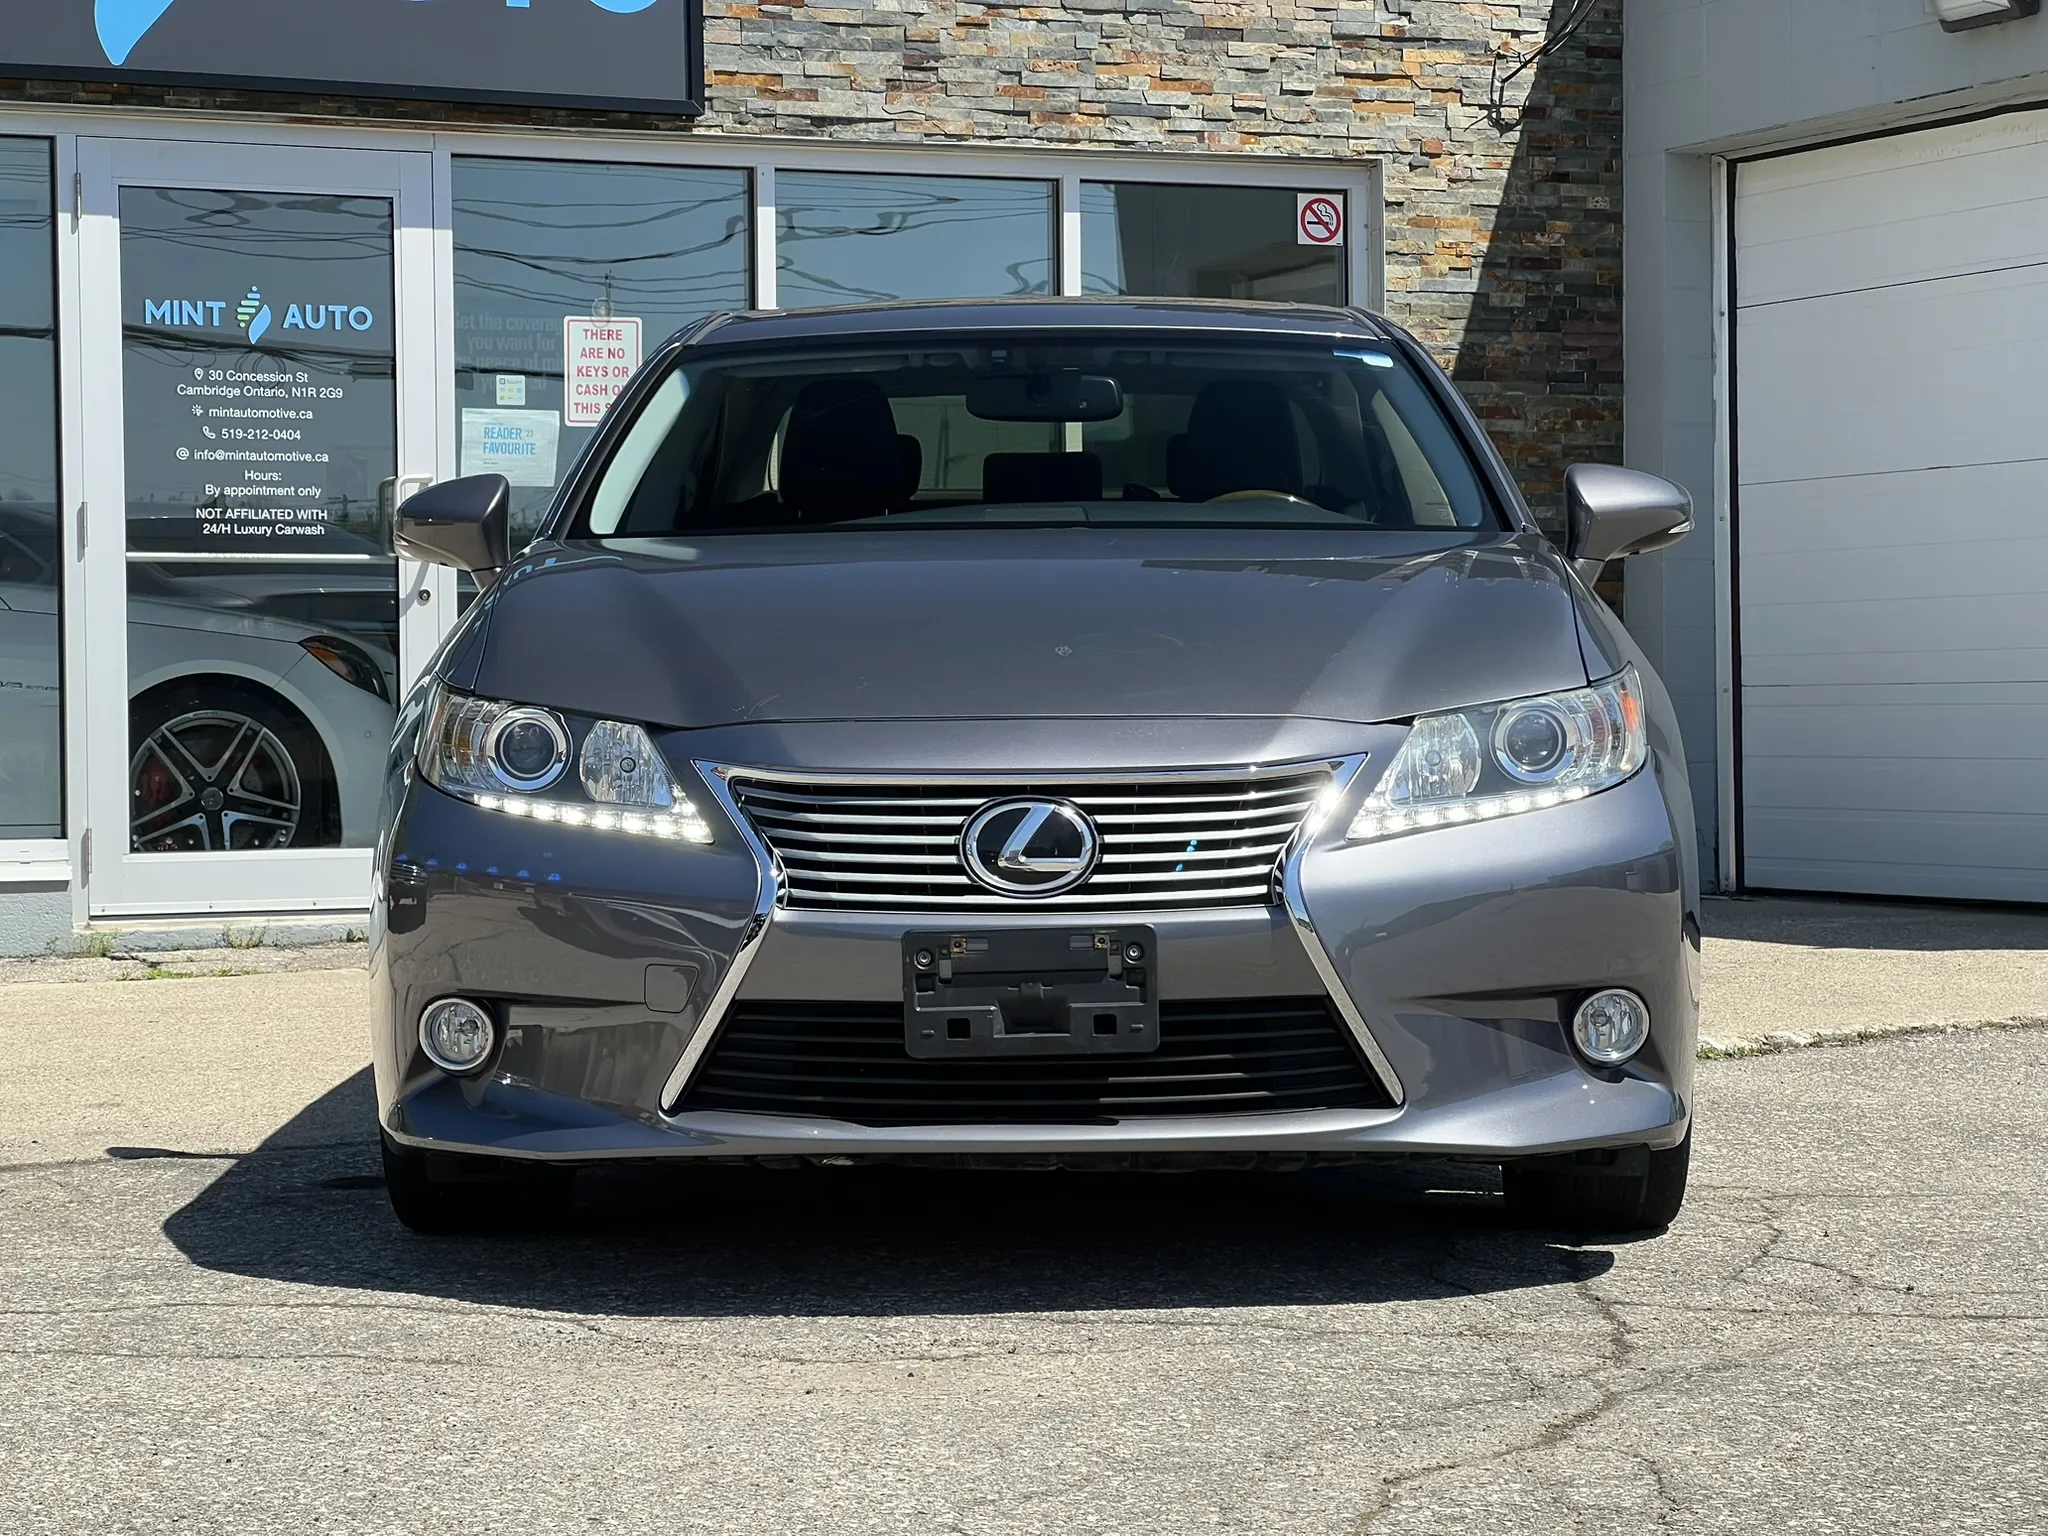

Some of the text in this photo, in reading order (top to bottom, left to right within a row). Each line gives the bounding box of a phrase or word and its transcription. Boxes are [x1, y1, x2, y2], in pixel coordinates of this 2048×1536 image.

[145, 299, 373, 331] MINT AUTO
[506, 317, 562, 336] coverag
[583, 329, 622, 341] THERE
[580, 347, 625, 359] ARE NO
[208, 370, 309, 383] 30 Concession St
[576, 366, 630, 378] KEYS OR
[177, 384, 343, 400] Cambridge Ontario, N1R 2G9
[576, 384, 625, 396] CASH O
[208, 407, 313, 420] mintautomotive.ca
[574, 402, 601, 414] THIS
[221, 428, 301, 440] 519-212-0404
[484, 426, 522, 440] READER
[483, 441, 536, 455] FAVOURITE
[194, 448, 329, 463] info@mintautomotive.ca
[244, 470, 282, 481] Hours:
[205, 484, 321, 498] By appointment only
[196, 508, 328, 521] NOT AFFILIATED WITH
[203, 523, 325, 537] 24/H Luxury Carwash
